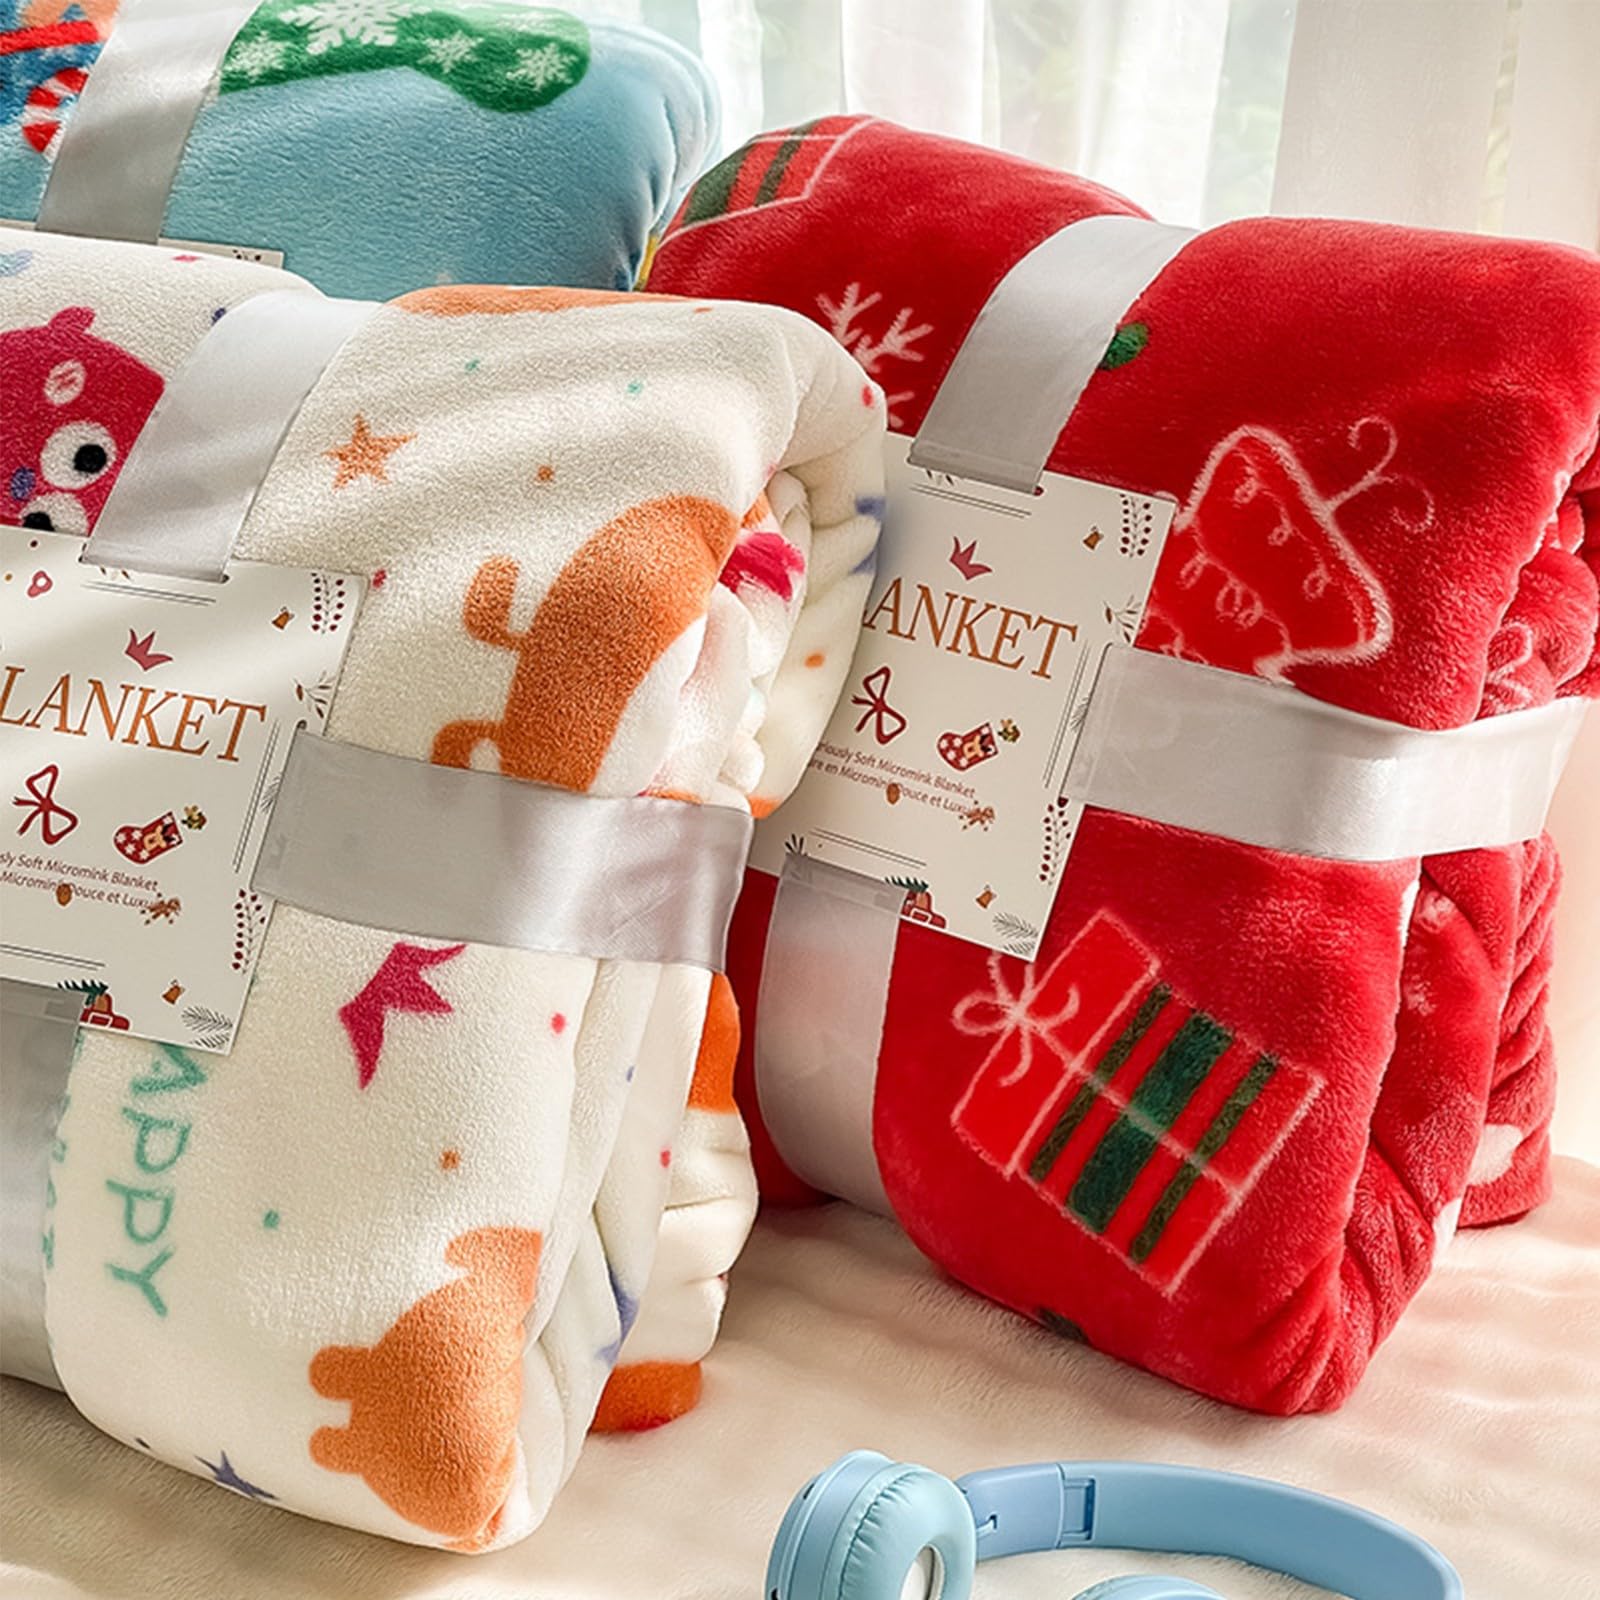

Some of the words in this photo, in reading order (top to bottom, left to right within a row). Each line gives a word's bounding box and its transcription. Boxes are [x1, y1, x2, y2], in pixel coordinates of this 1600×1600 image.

[863, 577, 1078, 679] ANKET
[0, 666, 267, 762] LANKET
[825, 763, 839, 774] en
[839, 766, 891, 790] Micromin
[929, 794, 942, 808] et
[854, 751, 876, 769] Soft
[877, 759, 932, 786] Micromink
[934, 775, 976, 799] Blanket
[0, 870, 61, 891] Micromin
[107, 892, 121, 904] et
[17, 853, 43, 871] Soft
[44, 859, 109, 881] Micromink
[111, 872, 158, 892] Blanket
